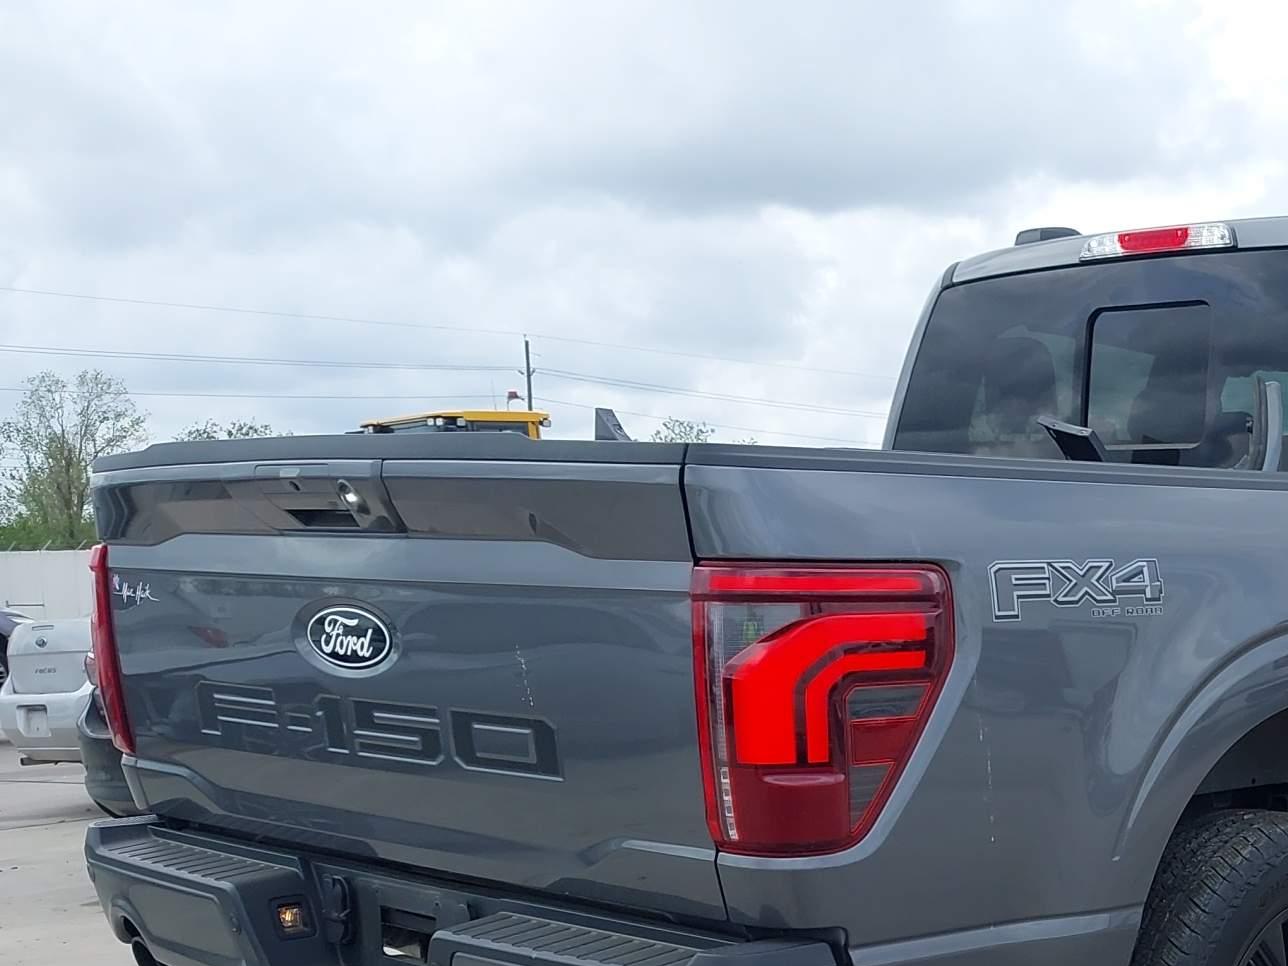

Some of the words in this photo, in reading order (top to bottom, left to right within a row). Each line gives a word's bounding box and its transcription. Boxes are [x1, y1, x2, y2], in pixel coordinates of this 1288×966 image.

[988, 559, 1164, 622] FX4
[1091, 607, 1121, 617] OFF
[1125, 606, 1163, 616] ROAD
[320, 615, 373, 657] Ford
[196, 680, 564, 782] F-150
